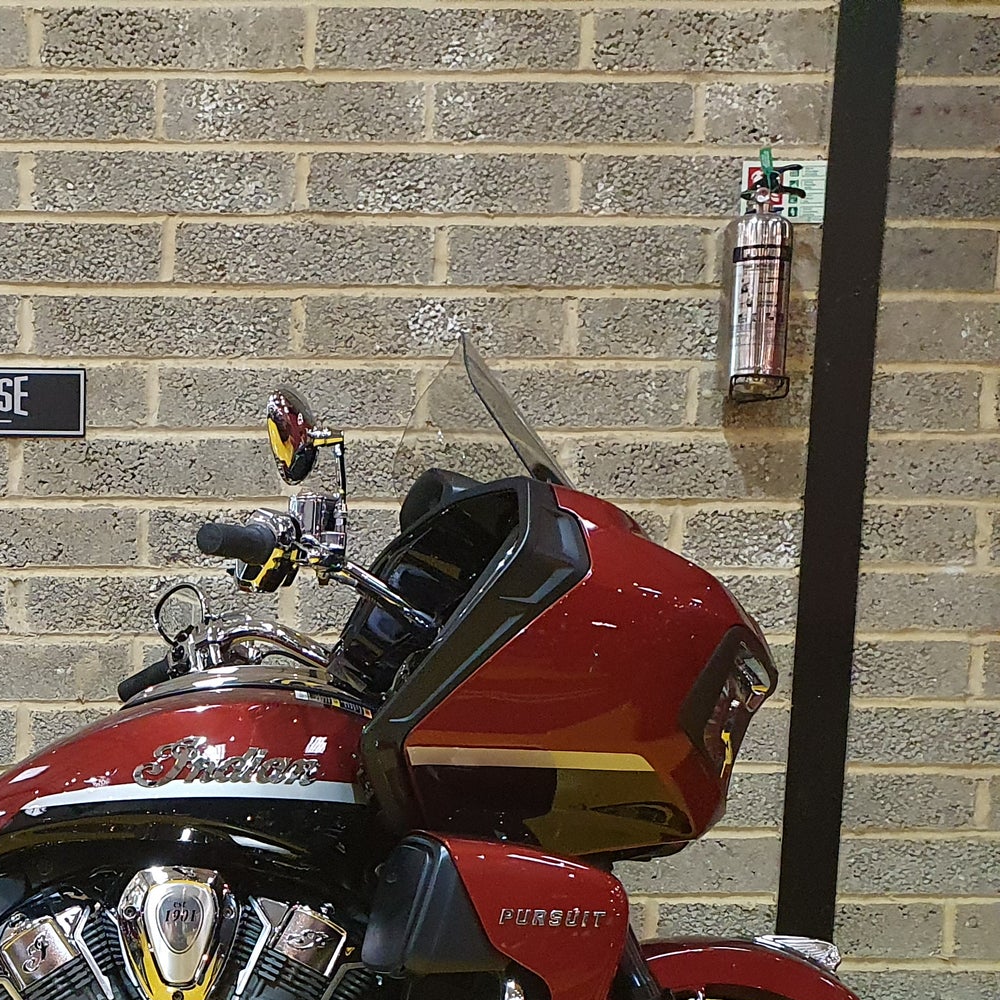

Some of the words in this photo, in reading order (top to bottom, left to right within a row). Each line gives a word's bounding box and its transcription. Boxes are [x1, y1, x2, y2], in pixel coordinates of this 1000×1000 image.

[132, 735, 321, 788] Indian
[164, 910, 197, 923] 1901
[498, 908, 607, 928] PURSUIT
